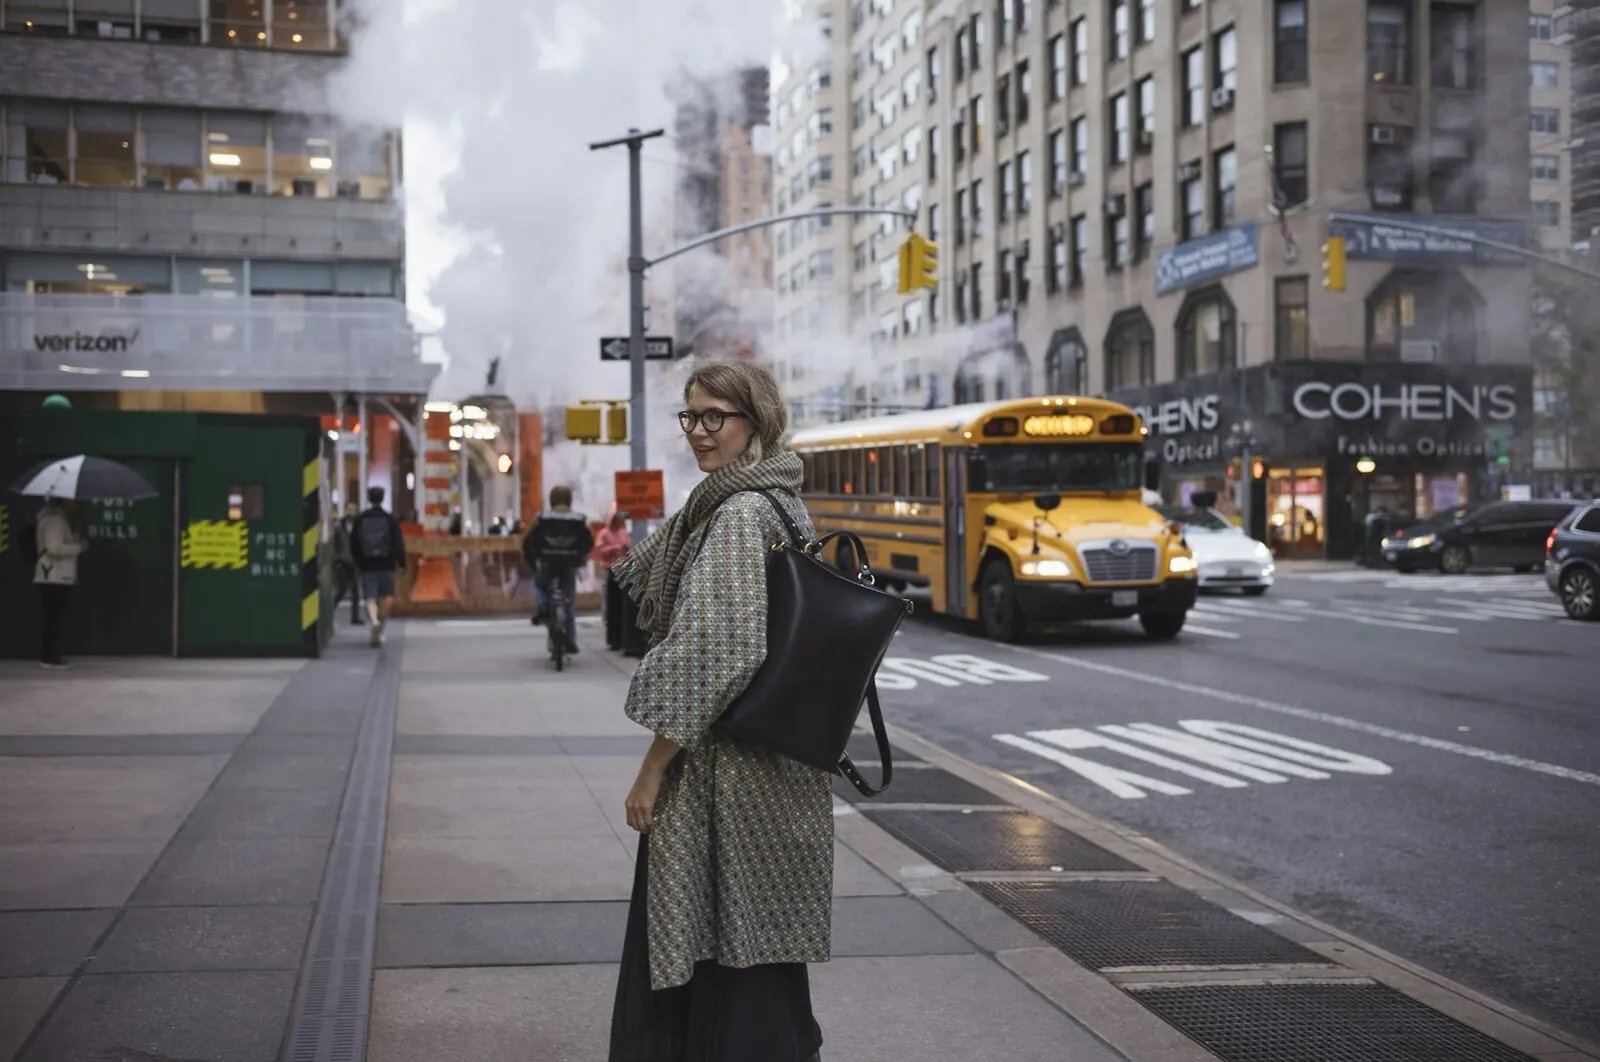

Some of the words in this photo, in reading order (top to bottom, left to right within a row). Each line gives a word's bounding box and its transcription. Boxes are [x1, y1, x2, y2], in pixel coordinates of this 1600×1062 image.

[33, 331, 127, 352] verizon
[1292, 381, 1517, 420] COHEN'S
[1163, 436, 1219, 465] Optical
[1337, 436, 1409, 456] Fashion
[1416, 435, 1491, 458] Optical
[103, 510, 125, 522] NO
[88, 525, 138, 539] BILLS
[255, 532, 296, 546] POST
[265, 548, 287, 560] NO
[251, 562, 299, 577] BILLS
[875, 654, 1051, 691] BUS
[991, 719, 1393, 800] ONLY
